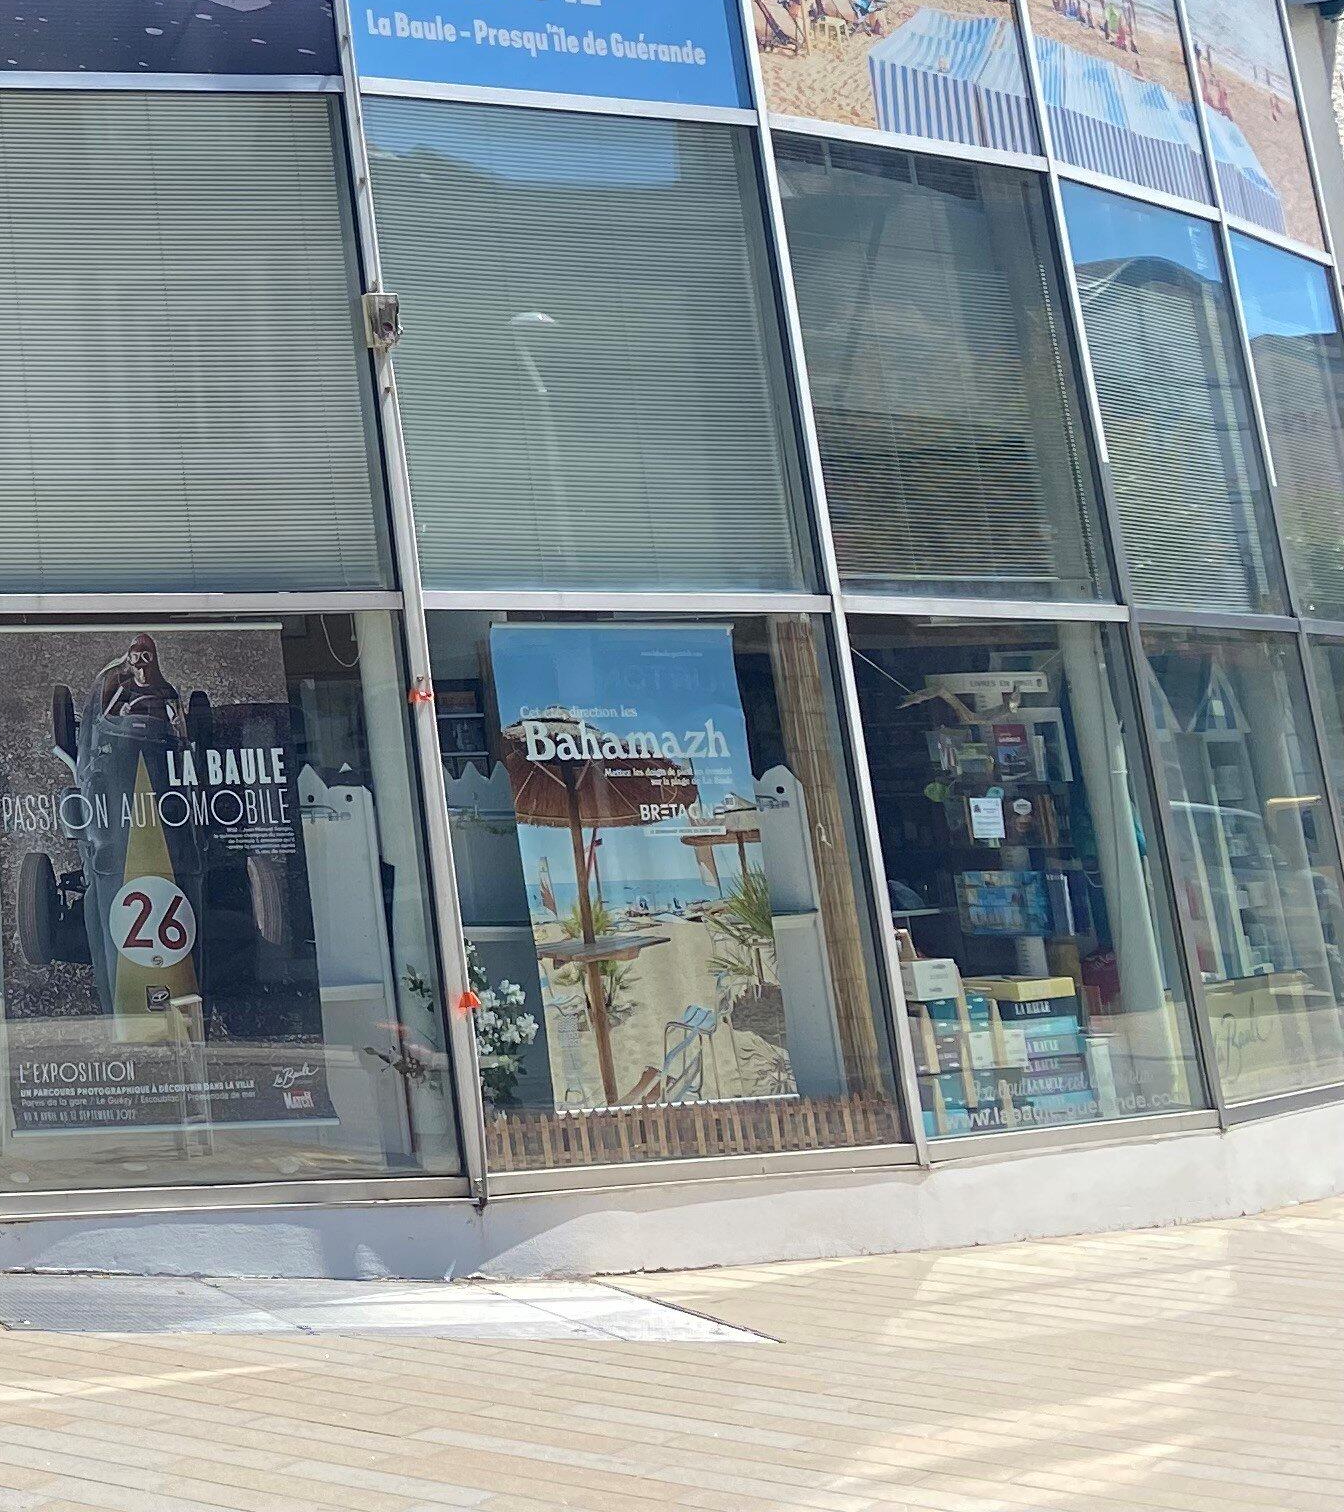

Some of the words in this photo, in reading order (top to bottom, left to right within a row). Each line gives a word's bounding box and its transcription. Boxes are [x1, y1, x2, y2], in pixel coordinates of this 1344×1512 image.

[366, 9, 391, 37] La
[394, 12, 457, 43] Baule
[583, 30, 607, 56] de
[610, 33, 706, 65] Guérande
[569, 706, 619, 718] direction
[621, 705, 638, 718] les
[522, 718, 731, 761] Bahamazh
[167, 749, 198, 786] LA
[207, 748, 287, 785] BAULE
[2, 793, 109, 832] PASSION
[121, 789, 291, 828] AUTOMOBILE
[122, 891, 187, 950] 26
[20, 1061, 135, 1084] L'EXPOSITION
[20, 1089, 32, 1098] UN
[33, 1088, 75, 1097] PARCOURS
[77, 1085, 150, 1096] PHOTOGRAPHIQUE
[204, 1081, 224, 1091] DANS
[225, 1081, 234, 1090] LA
[236, 1080, 255, 1089] VILLE
[48, 1097, 58, 1107] de
[59, 1097, 68, 1106] la
[69, 1098, 87, 1108] gare
[96, 1096, 106, 1105] Le
